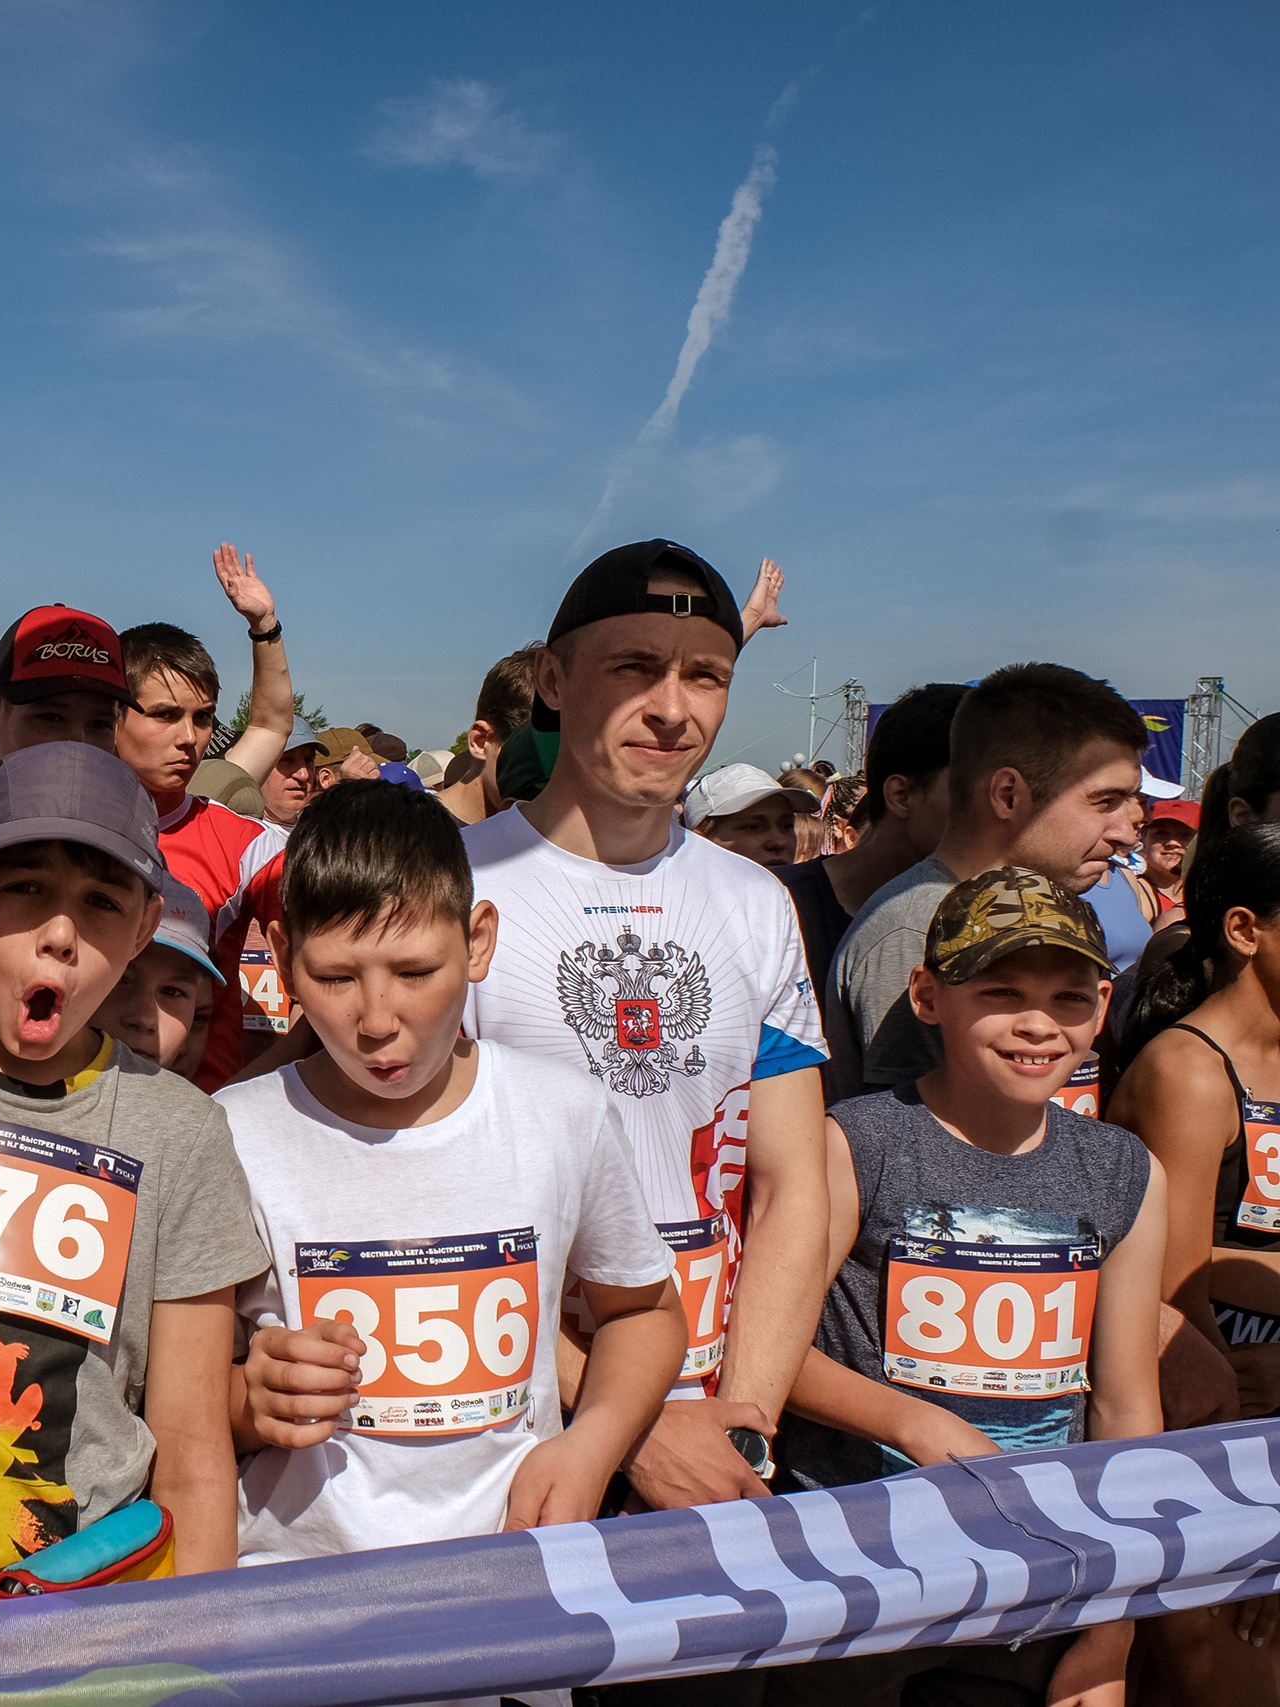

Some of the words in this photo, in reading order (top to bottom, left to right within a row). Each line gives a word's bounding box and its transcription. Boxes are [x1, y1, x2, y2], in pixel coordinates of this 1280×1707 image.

[36, 642, 109, 664] BORUS
[0, 1129, 17, 1140] БЕГА
[360, 1250, 404, 1259] ФЕСТИВАЛЬ
[405, 1248, 425, 1256] БЕГА
[896, 1275, 1083, 1360] 801
[314, 1277, 530, 1387] 356
